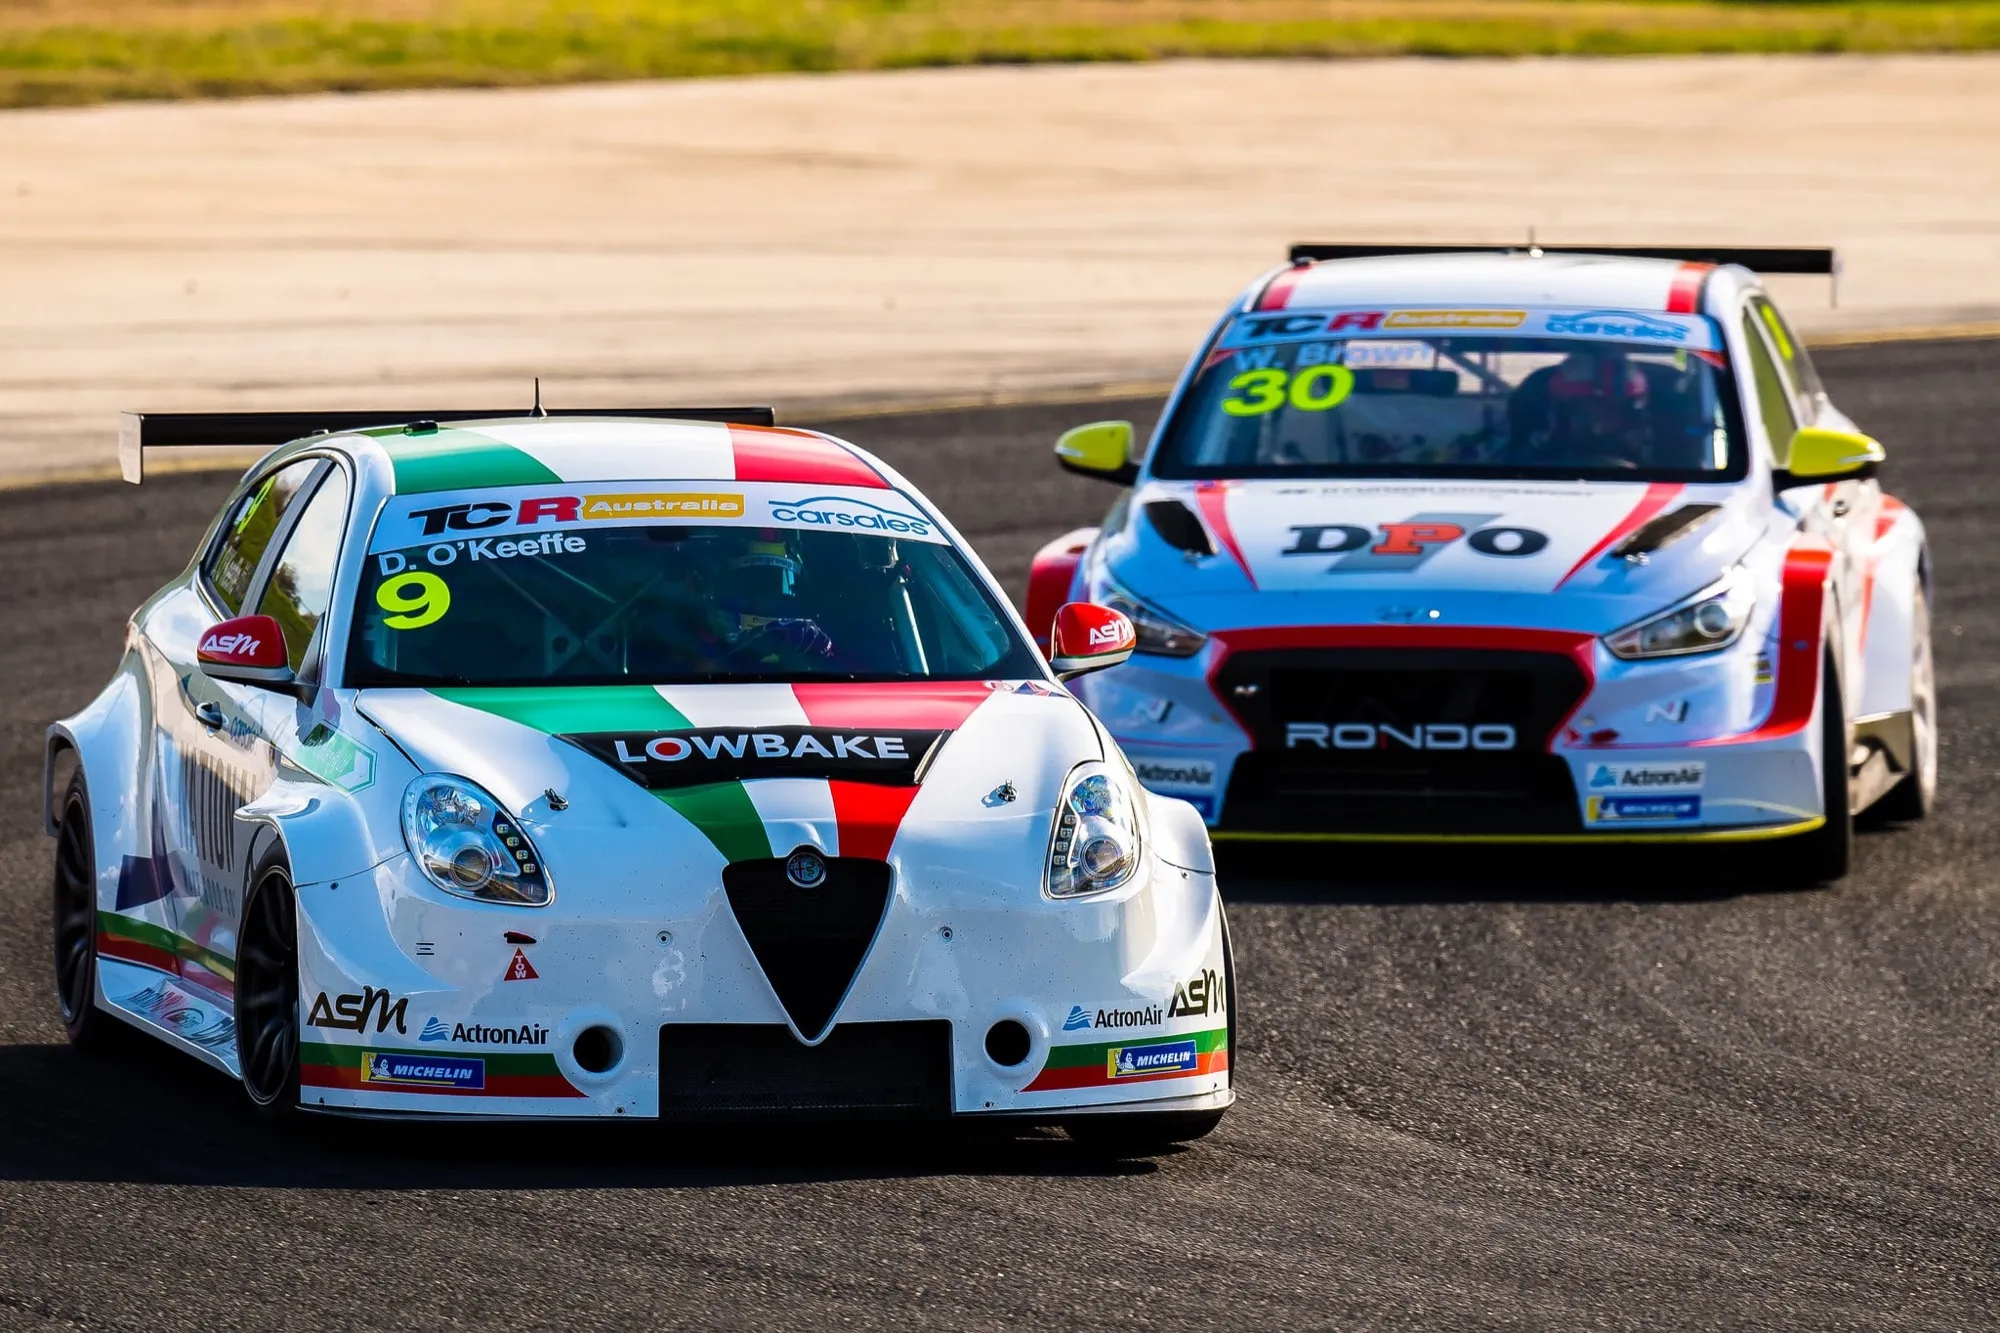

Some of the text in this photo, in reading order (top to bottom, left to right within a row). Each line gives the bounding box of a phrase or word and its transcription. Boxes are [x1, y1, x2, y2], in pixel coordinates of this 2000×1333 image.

[1244, 311, 1387, 337] TCR
[1233, 341, 1433, 371] W. Brown
[1222, 364, 1355, 416] 30
[408, 496, 739, 536] TCR Australia
[771, 506, 929, 536] carsales
[378, 533, 587, 576] D. O'Keeffe
[1282, 522, 1550, 559] DPO
[376, 571, 450, 630] 9
[202, 633, 261, 656] ASM
[1089, 620, 1133, 646] ASM
[613, 732, 910, 763] LOWBAKE
[1285, 722, 1518, 750] RONDO
[514, 955, 527, 979] TOW
[1167, 968, 1225, 1018] ASM
[306, 984, 410, 1035] ASM
[1094, 1003, 1163, 1029] ActronAir
[451, 1022, 550, 1046] ActronAir
[393, 1064, 474, 1080] MICHELIN
[1136, 1050, 1191, 1067] MICHELIN
